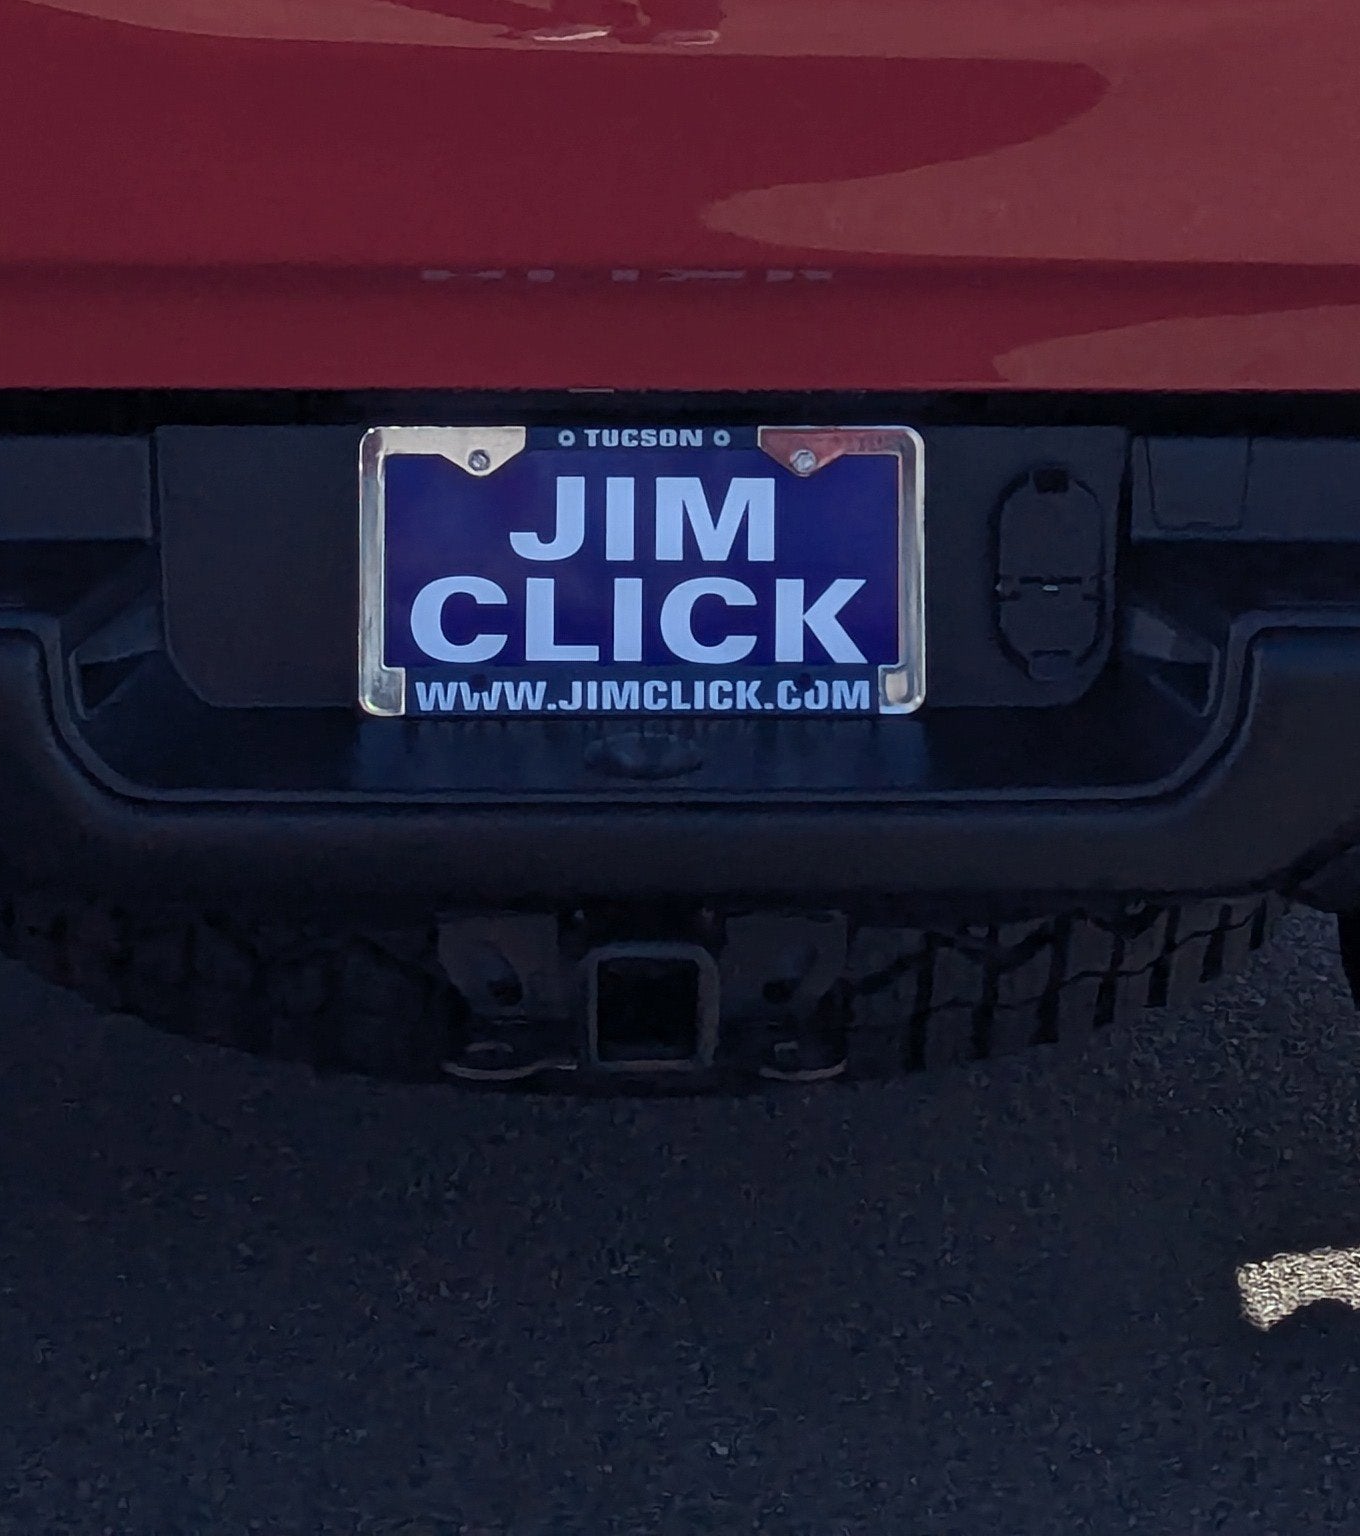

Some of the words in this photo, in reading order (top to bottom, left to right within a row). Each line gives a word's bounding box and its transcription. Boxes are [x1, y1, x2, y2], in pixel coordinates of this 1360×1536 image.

[583, 428, 703, 448] TUCSON
[509, 475, 776, 562] JIM
[409, 575, 869, 664] CLICK
[414, 679, 871, 712] WWW.JIMCLICK.COM
